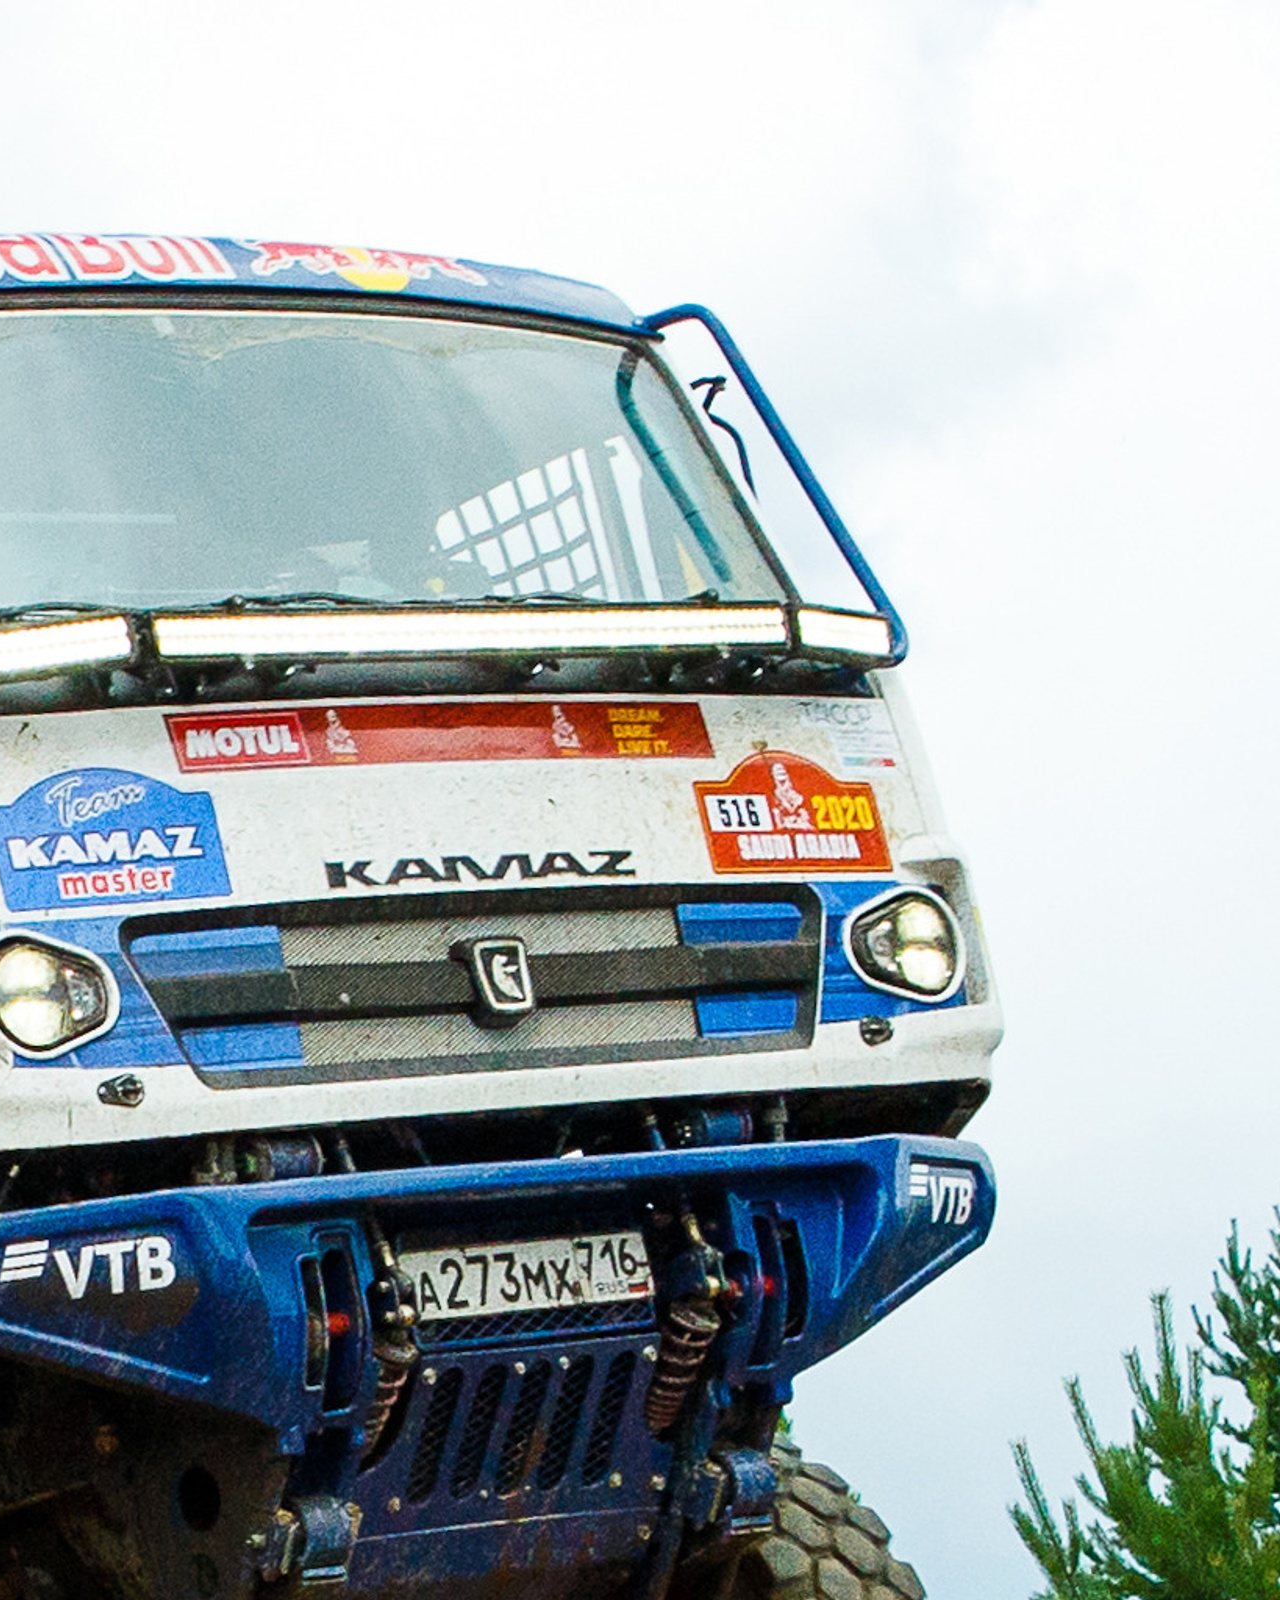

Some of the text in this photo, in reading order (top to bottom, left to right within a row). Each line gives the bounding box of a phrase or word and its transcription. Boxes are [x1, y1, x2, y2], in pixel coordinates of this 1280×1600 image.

[185, 724, 300, 759] MOTUL
[46, 776, 147, 827] Team
[716, 799, 761, 828] 516
[810, 795, 876, 830] 2020
[6, 825, 205, 871] KAMAZ
[737, 833, 795, 861] SAUDI
[59, 866, 176, 898] master
[323, 850, 637, 889] KAMAZ
[929, 1175, 974, 1225] VTB
[52, 1235, 177, 1300] VTB
[595, 1280, 627, 1295] RUS
